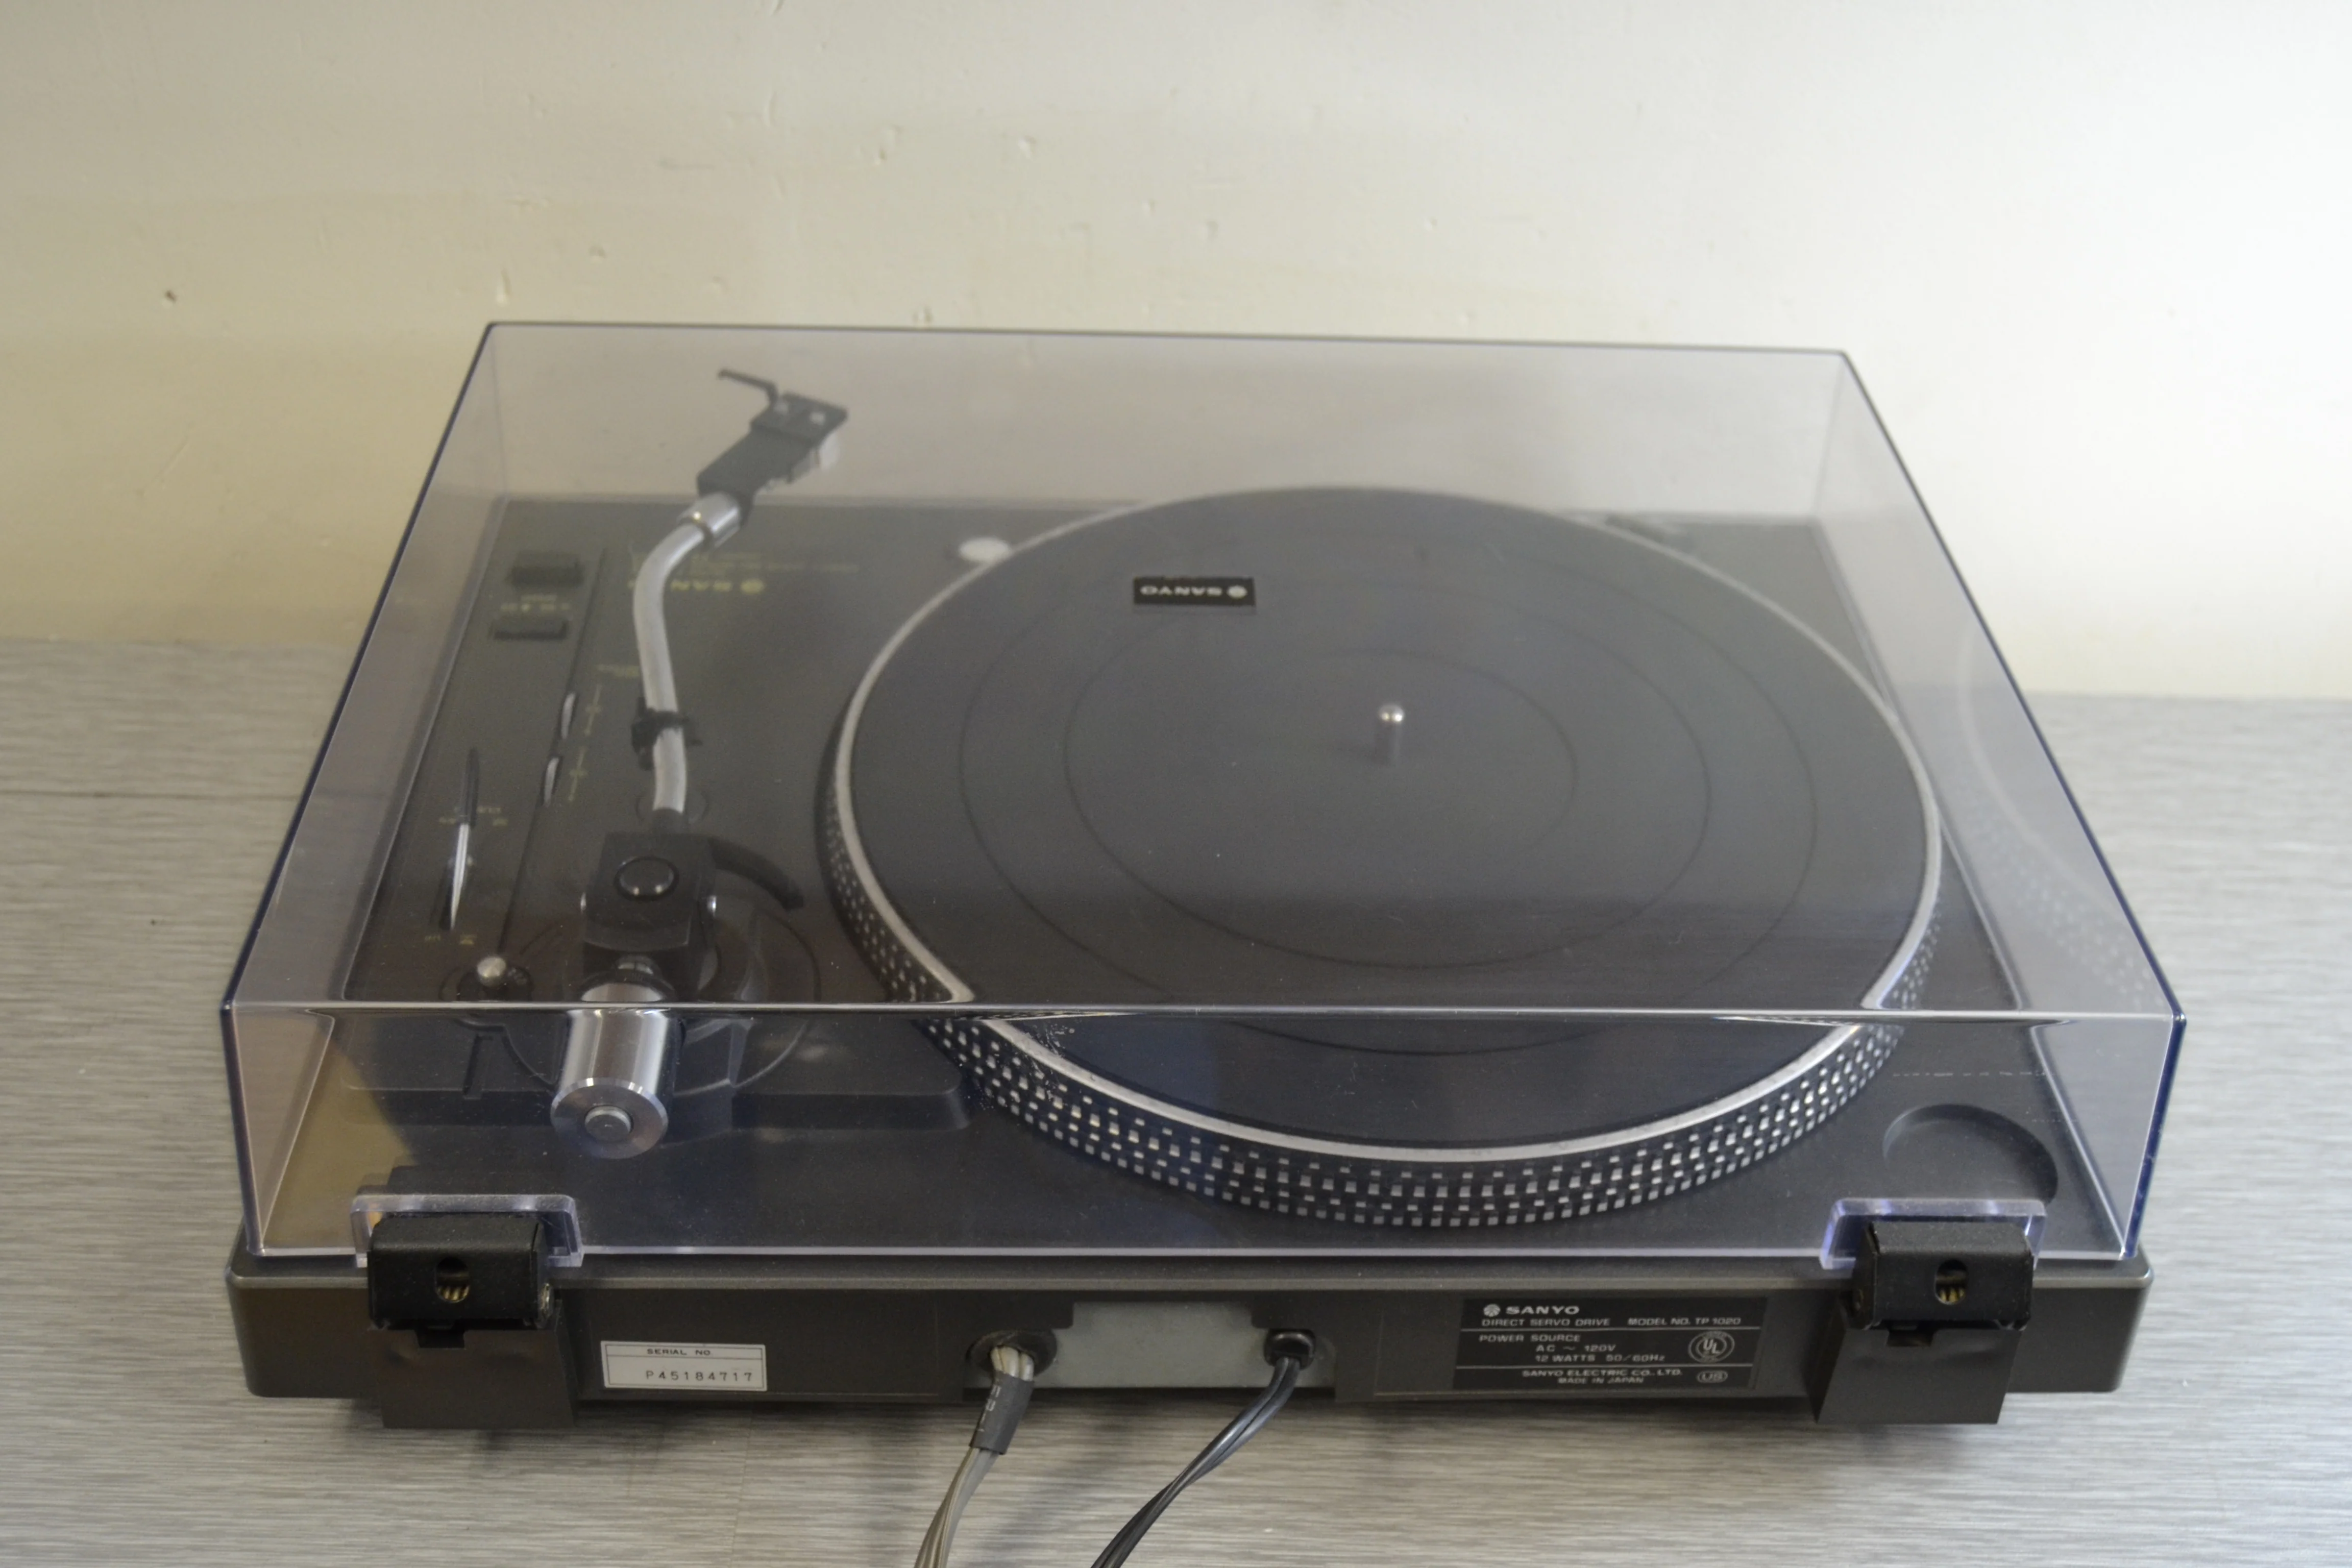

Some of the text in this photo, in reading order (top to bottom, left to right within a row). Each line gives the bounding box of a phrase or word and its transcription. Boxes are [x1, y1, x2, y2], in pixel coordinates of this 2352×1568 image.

[1140, 585, 1223, 597] SANYO
[1506, 1306, 1580, 1315] SANYO
[1482, 1317, 1742, 1327] DIRECT SERVO DRIVE MODEL NO. TP 1020
[1479, 1334, 1581, 1342] POWER SOURCE
[1535, 1344, 1556, 1353] AC
[1585, 1344, 1616, 1352] 120V
[1552, 1354, 1596, 1362] WATTS
[645, 1370, 752, 1382] P45184717
